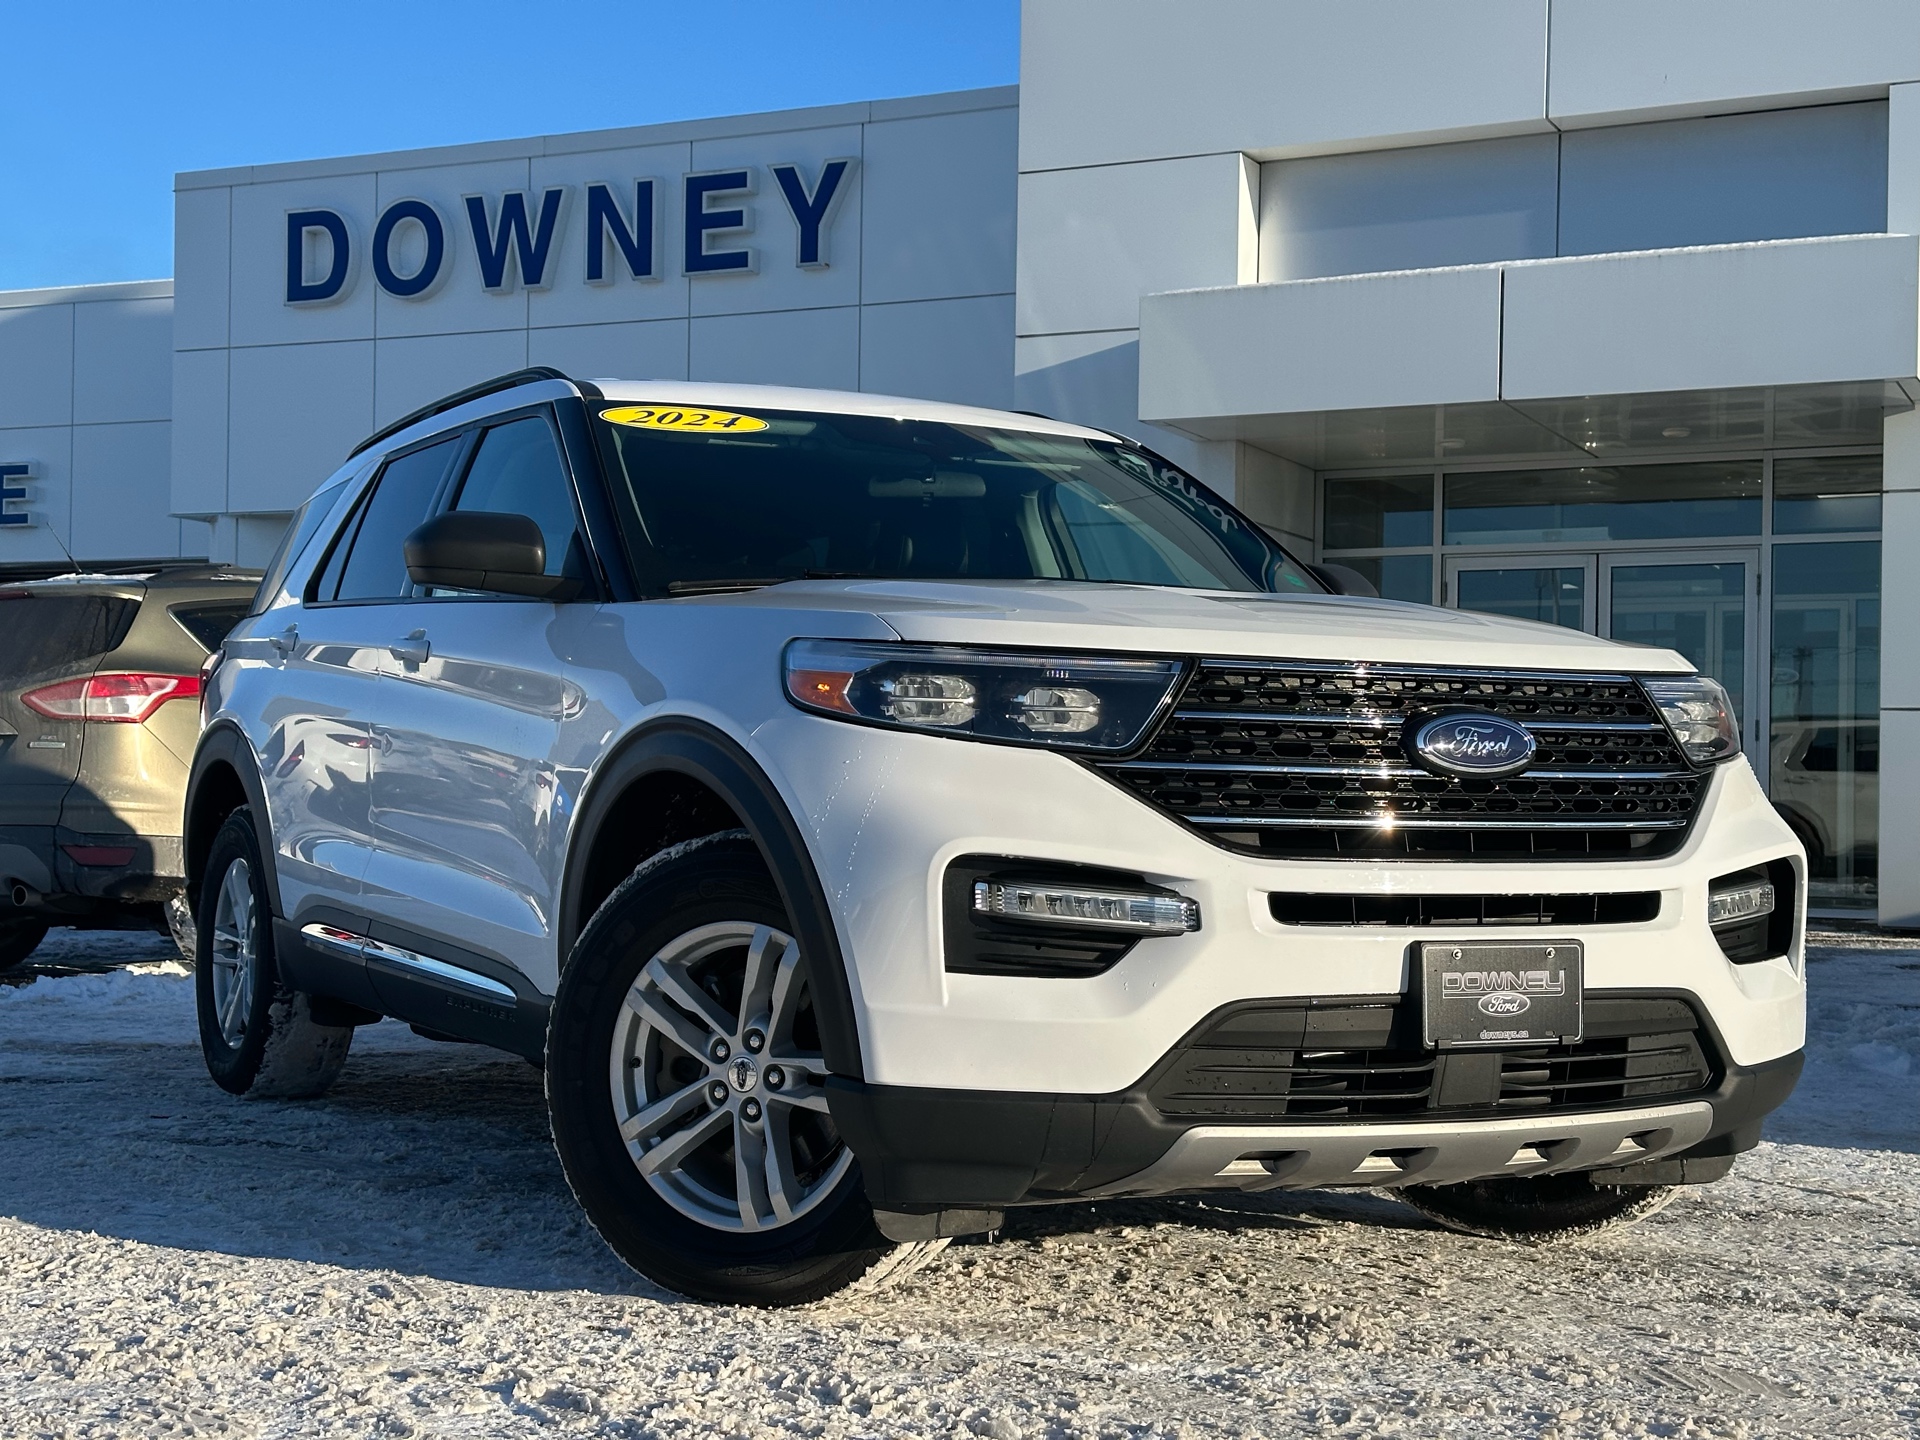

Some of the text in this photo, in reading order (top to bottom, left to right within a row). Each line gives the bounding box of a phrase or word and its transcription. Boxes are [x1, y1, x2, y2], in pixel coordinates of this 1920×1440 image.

[286, 158, 852, 304] DOWNEY
[626, 410, 738, 428] 2024
[1450, 724, 1512, 758] Ford
[1442, 970, 1565, 992] DOWNEY
[1488, 995, 1520, 1013] Ford
[1480, 1029, 1529, 1040] downeys.ca
